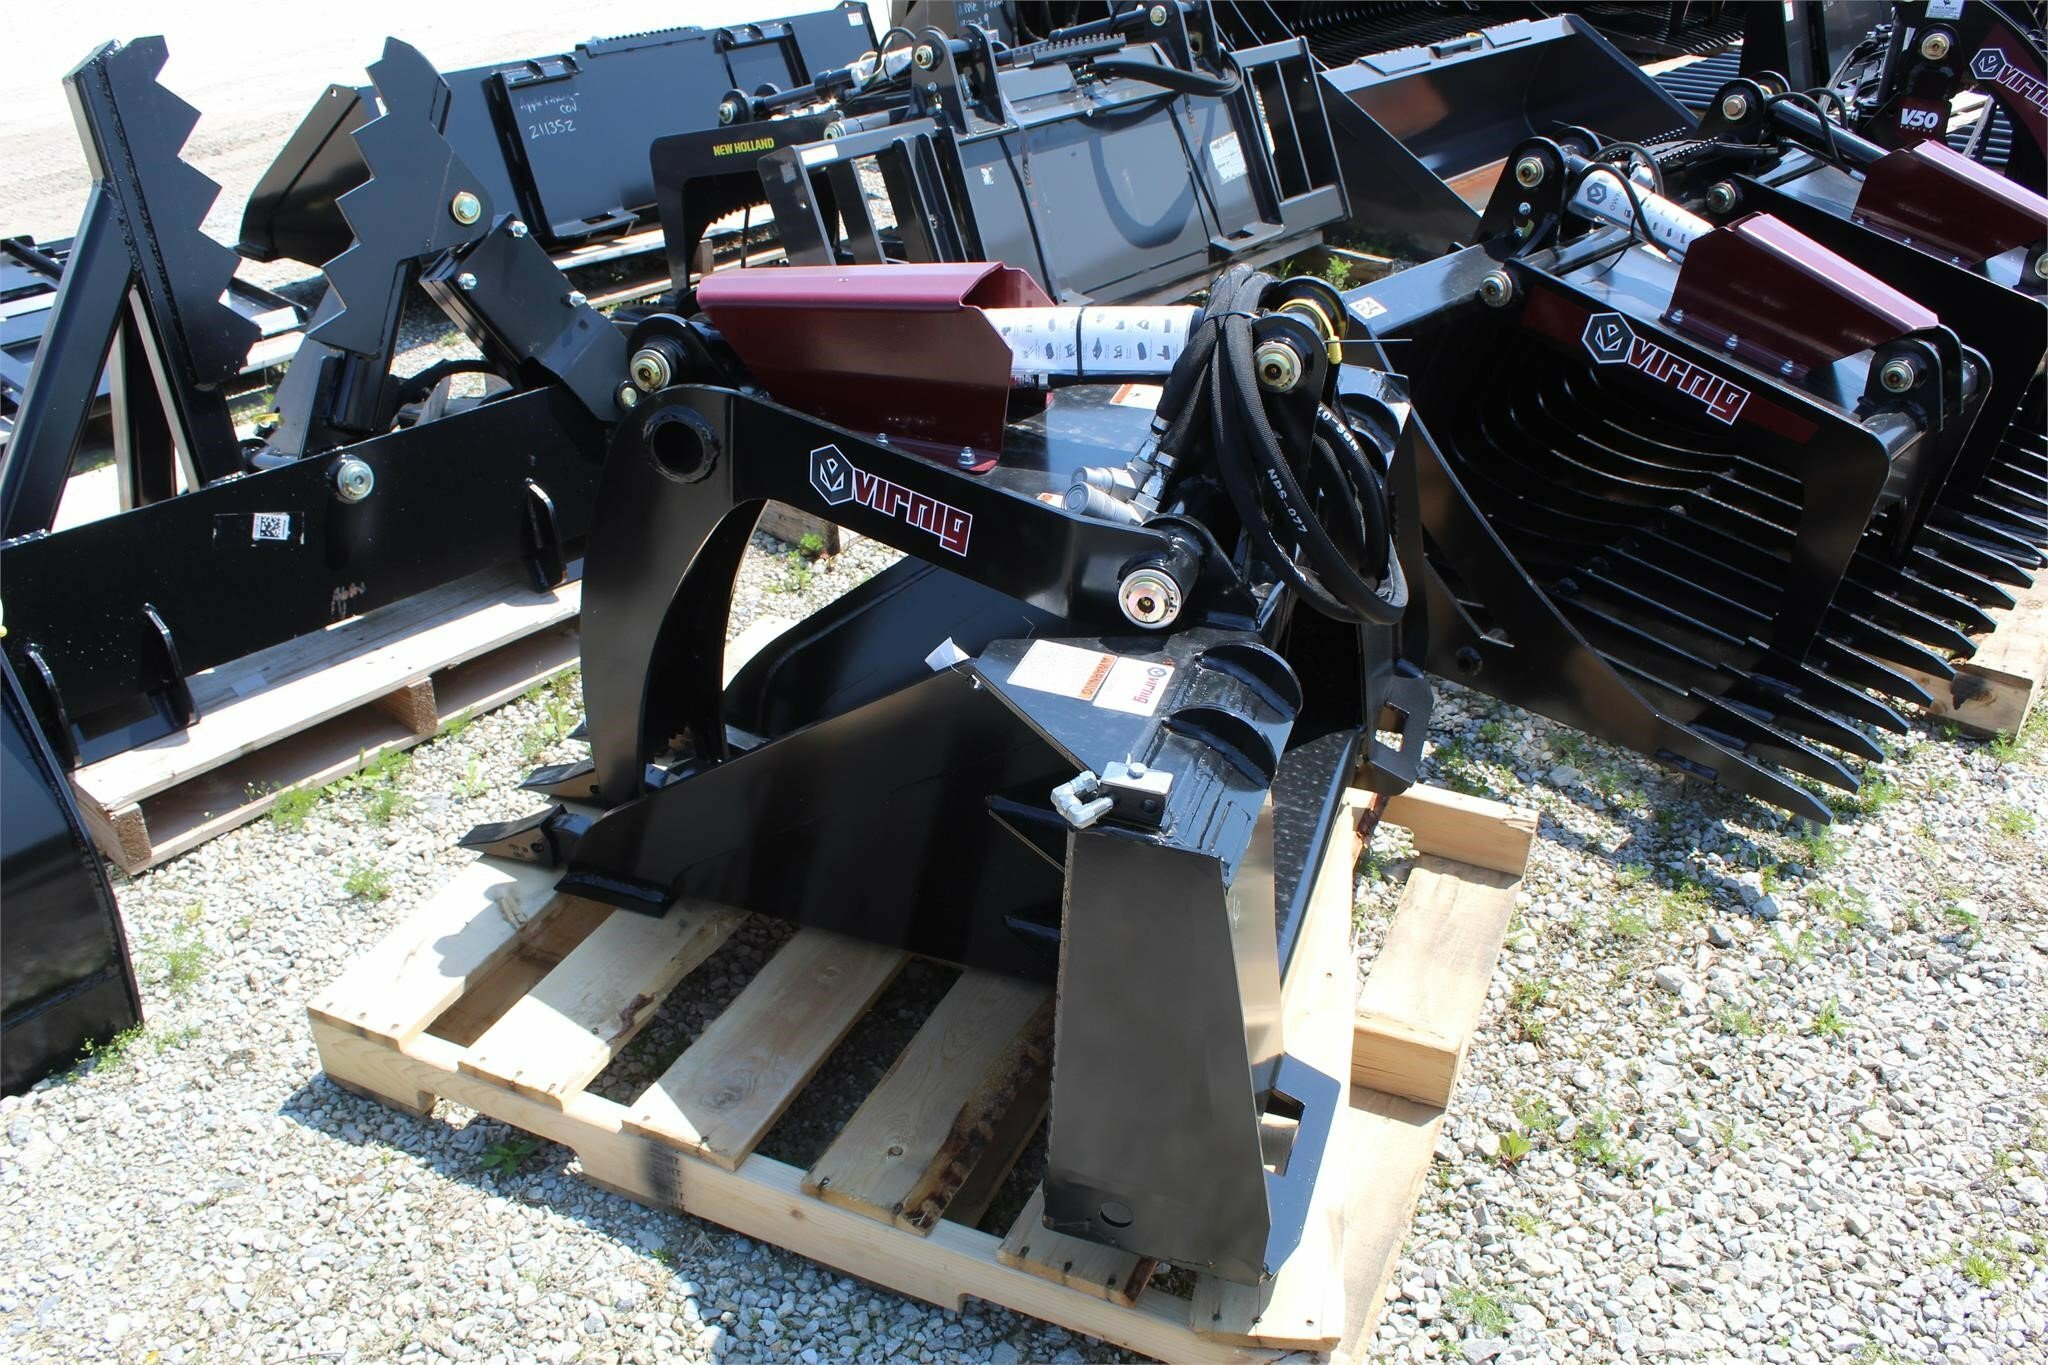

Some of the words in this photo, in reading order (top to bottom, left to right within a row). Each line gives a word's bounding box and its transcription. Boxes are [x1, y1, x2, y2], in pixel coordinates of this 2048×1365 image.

[1901, 108, 1939, 129] V50
[529, 119, 577, 140] 211352
[712, 143, 734, 156] NEW
[733, 137, 775, 154] HOLLAND
[1266, 468, 1308, 534] NPS-077
[1081, 660, 1108, 696] WARNING
